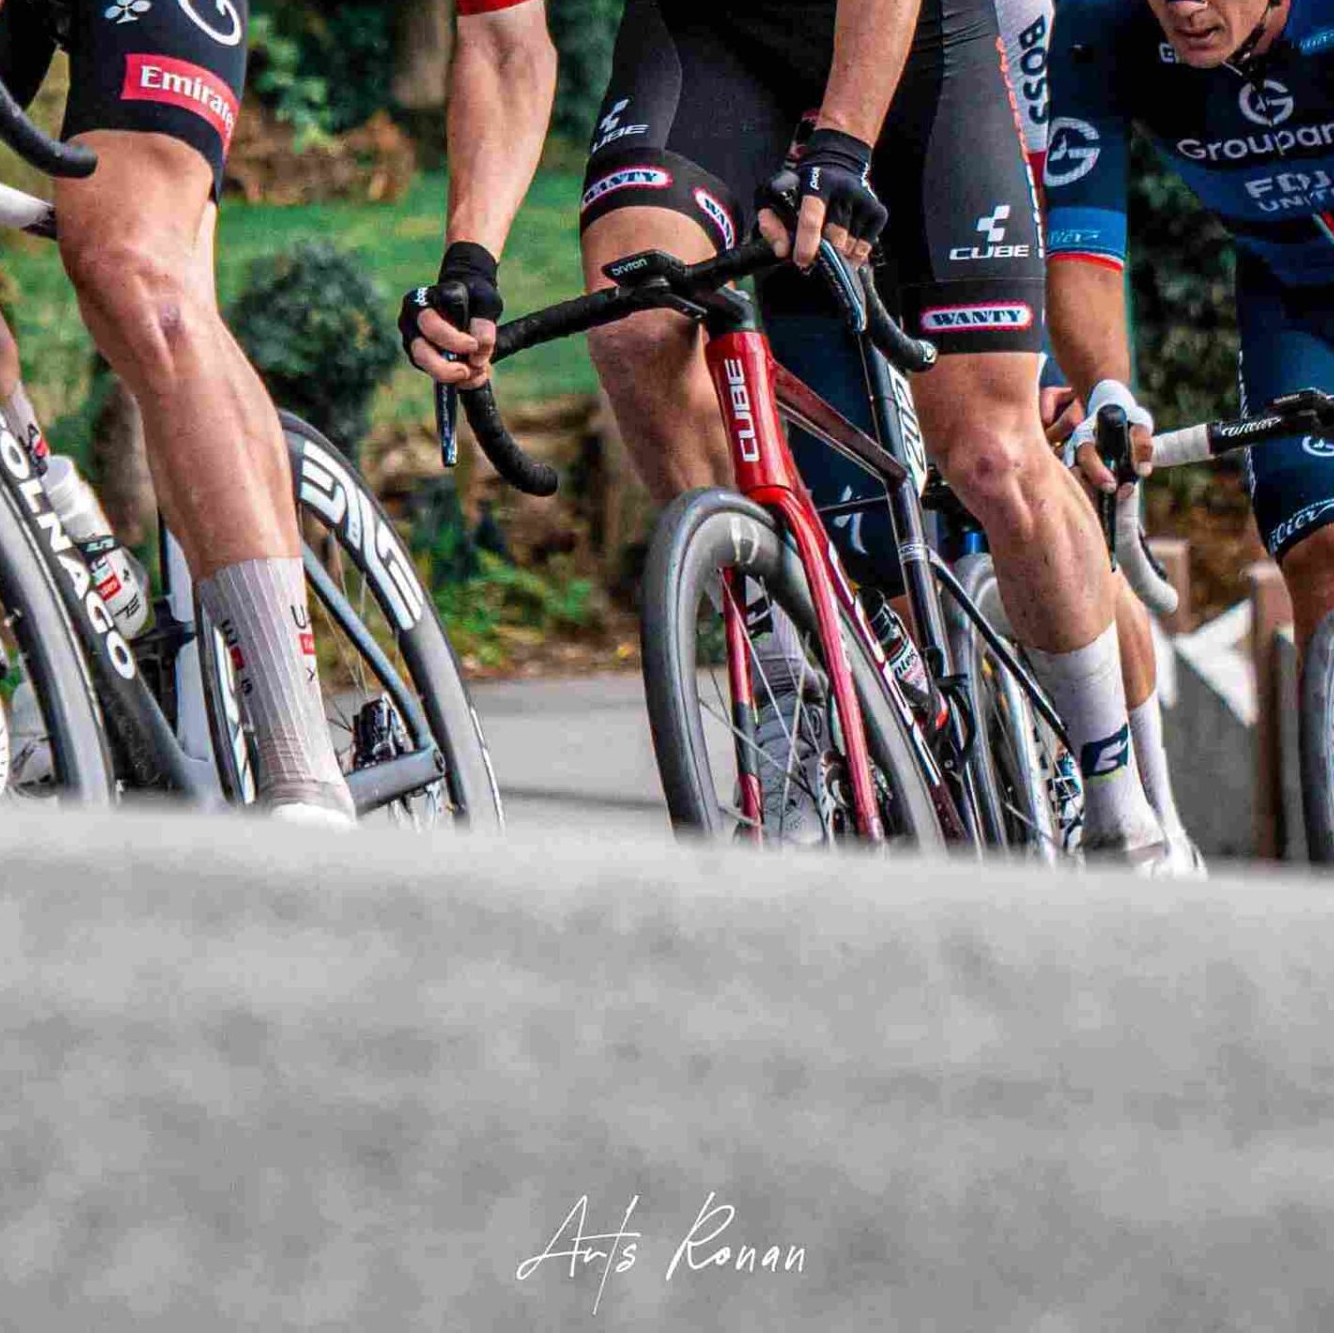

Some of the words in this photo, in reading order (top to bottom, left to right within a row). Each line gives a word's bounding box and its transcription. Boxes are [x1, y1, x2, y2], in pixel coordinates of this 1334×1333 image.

[591, 123, 651, 154] UBE
[1244, 170, 1333, 199] FDJ
[949, 244, 1030, 261] CUBE
[932, 308, 1023, 327] WANTY
[724, 357, 761, 464] CUBE
